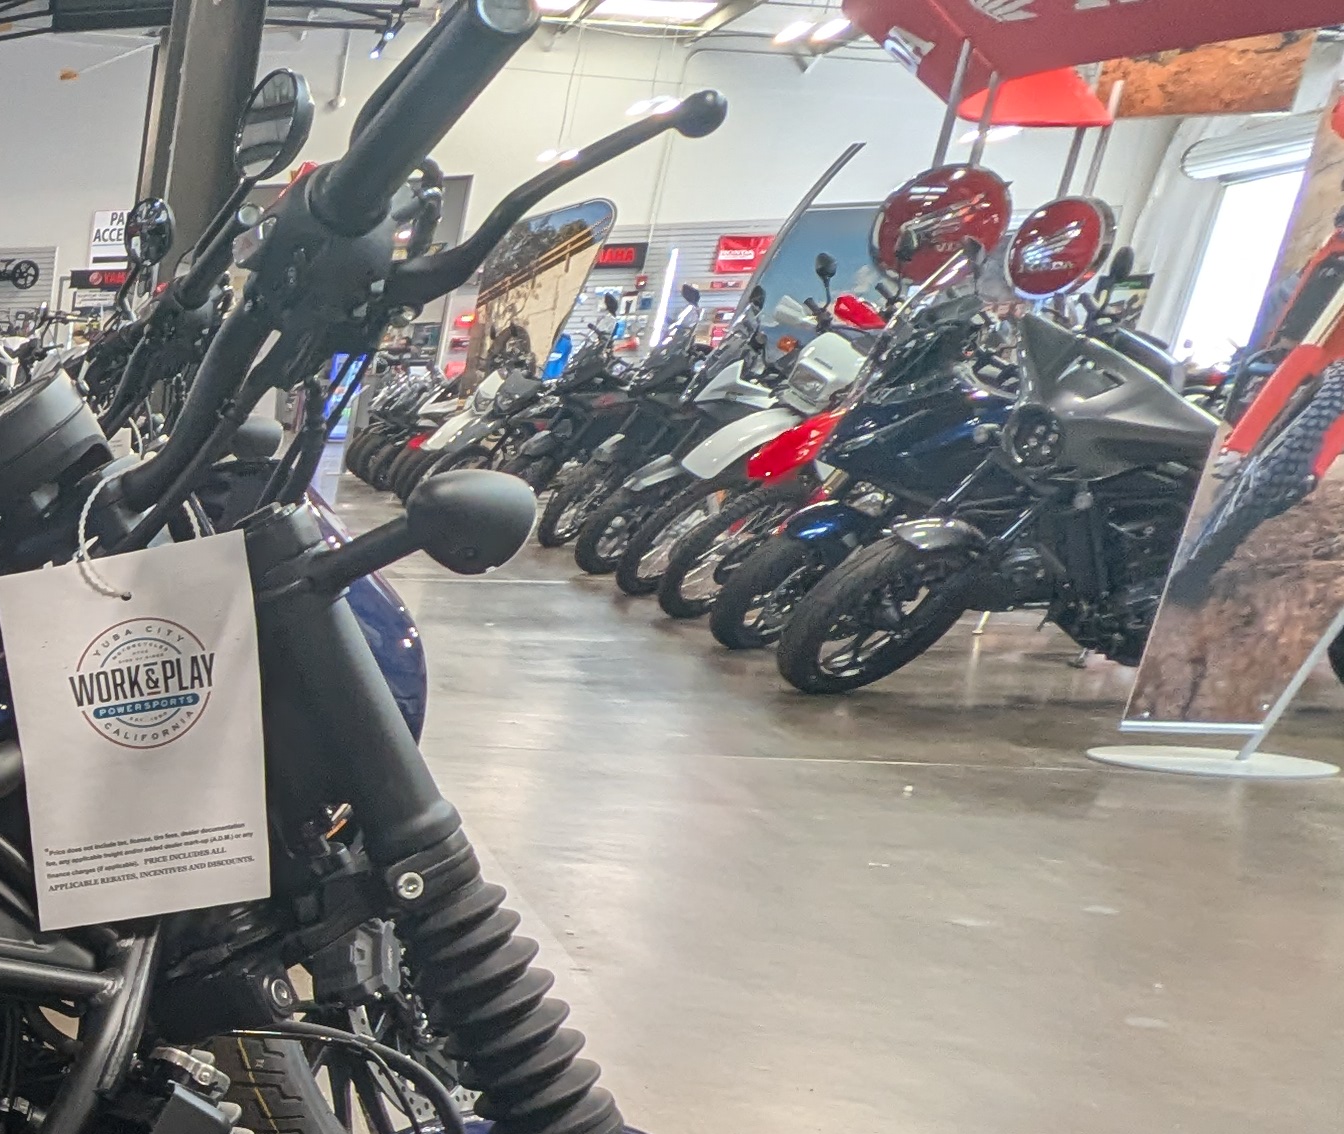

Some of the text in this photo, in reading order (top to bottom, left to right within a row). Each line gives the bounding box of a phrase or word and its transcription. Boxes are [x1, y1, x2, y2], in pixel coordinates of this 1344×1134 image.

[110, 212, 125, 226] PA
[93, 228, 124, 242] ACCE
[92, 625, 184, 657] YUBA CITY
[99, 695, 194, 717] POWERSPORTS
[104, 711, 194, 741] CALIFORNIA
[201, 823, 245, 833] documentation
[144, 855, 168, 865] PRICE
[169, 849, 210, 860] INCLUDES
[211, 847, 227, 855] ALL
[48, 855, 255, 891] APPLICABLE REBATES, INCENTIVES AND DISCOUNTS.
